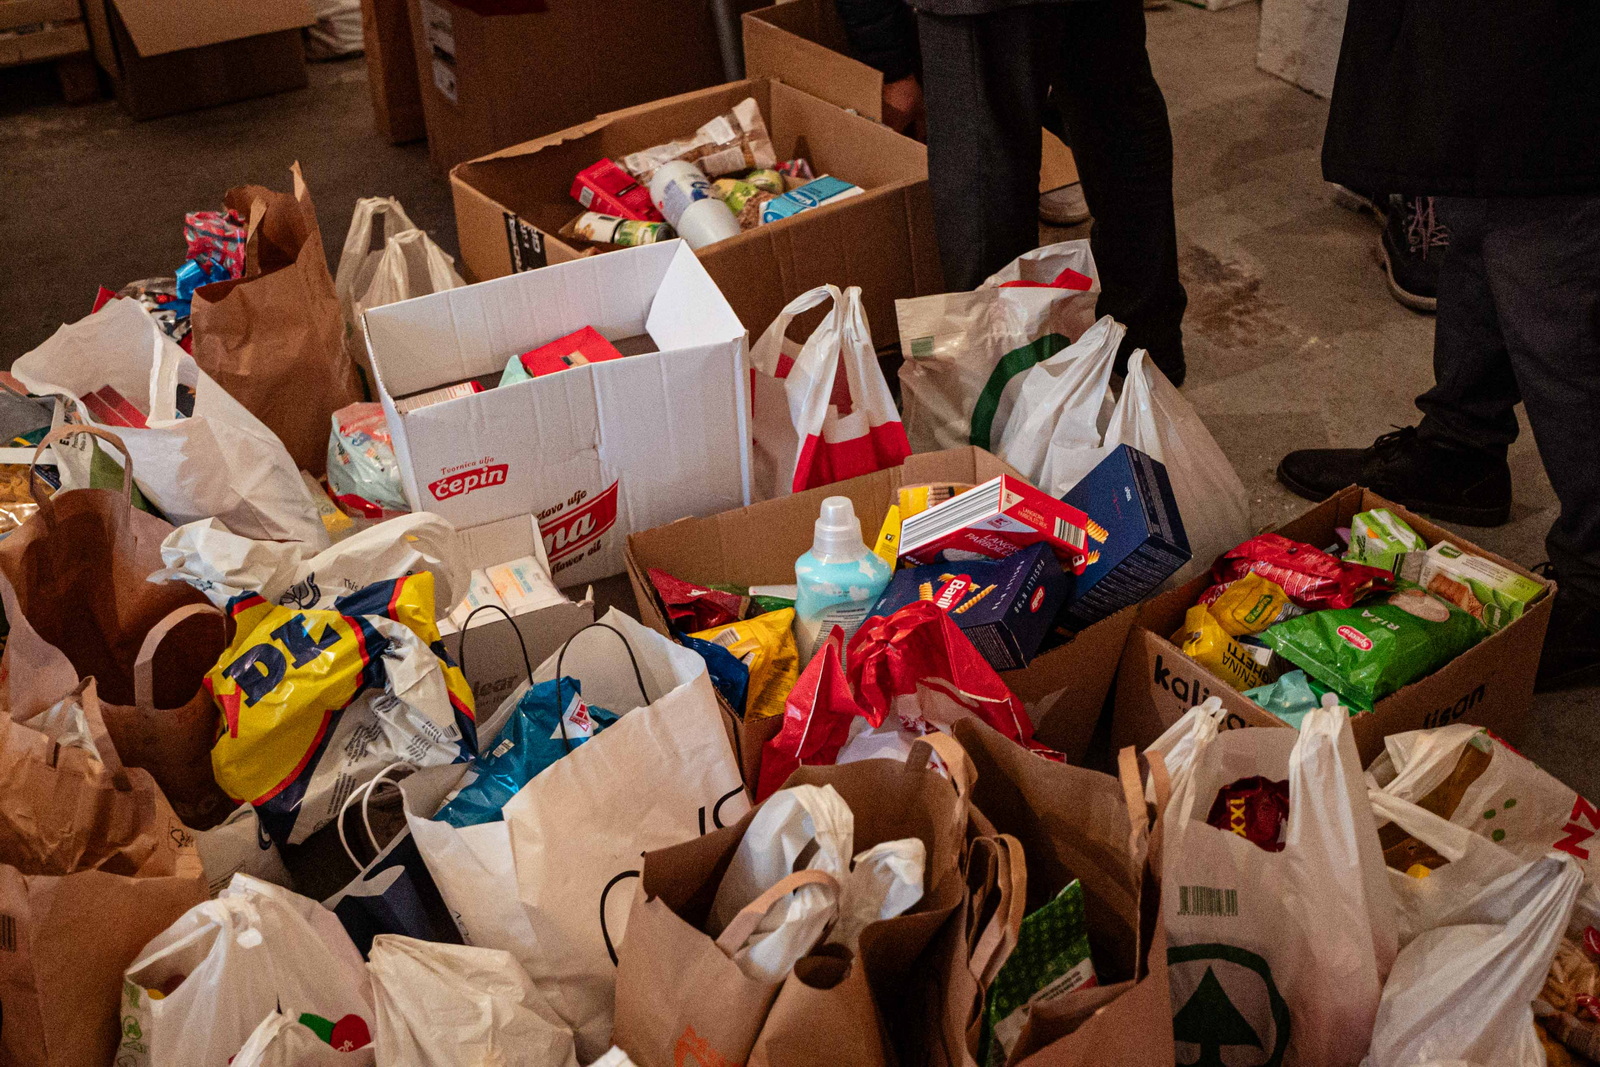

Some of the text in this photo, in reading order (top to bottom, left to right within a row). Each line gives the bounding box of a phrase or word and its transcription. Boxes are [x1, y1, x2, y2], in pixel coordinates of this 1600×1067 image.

[435, 466, 504, 497] čepin
[441, 462, 476, 475] Tvornica
[936, 578, 967, 610] Barill
